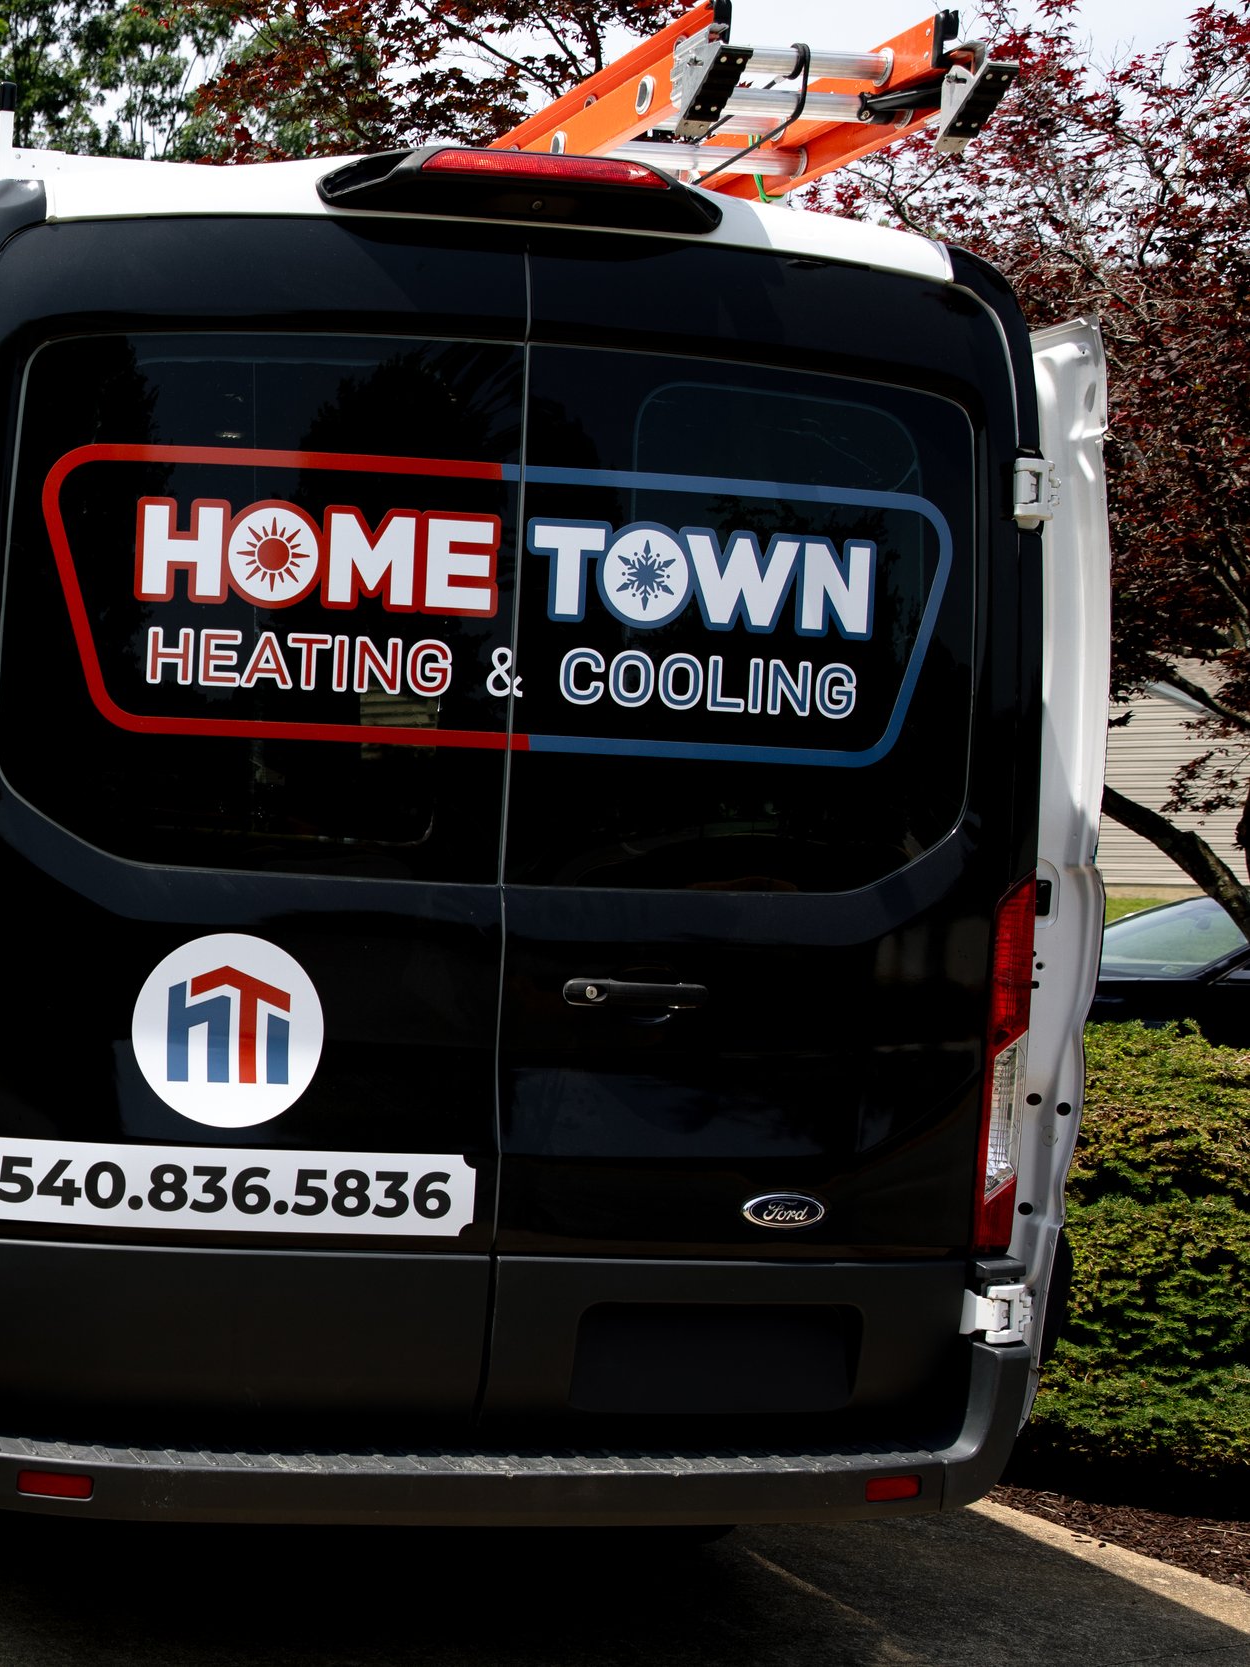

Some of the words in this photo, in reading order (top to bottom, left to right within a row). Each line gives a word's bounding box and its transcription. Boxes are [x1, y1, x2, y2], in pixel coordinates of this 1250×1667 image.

[135, 496, 501, 617] HOME
[527, 518, 876, 640] TOWN
[146, 627, 452, 697] HEATING
[486, 648, 523, 698] &
[560, 648, 858, 720] COOLING
[763, 1200, 809, 1221] Ford
